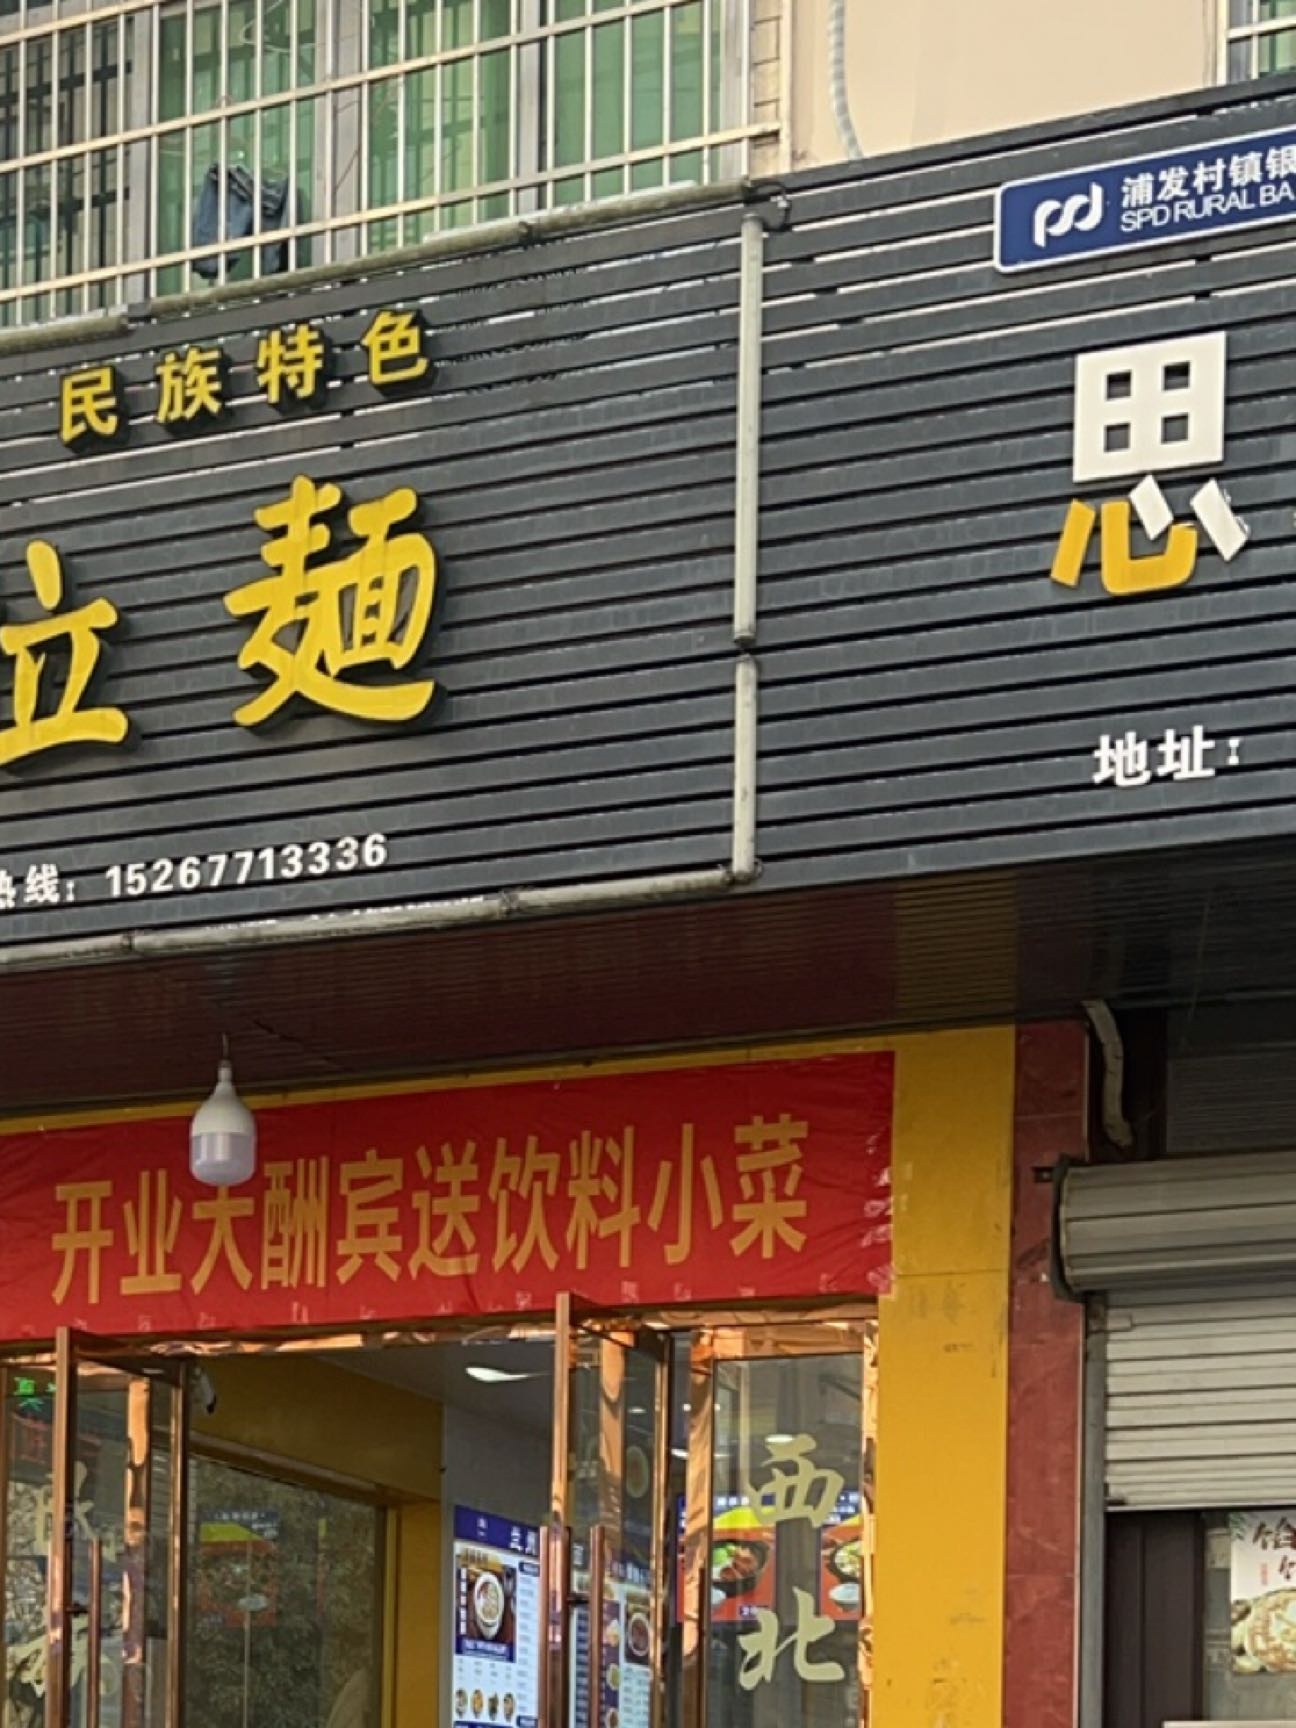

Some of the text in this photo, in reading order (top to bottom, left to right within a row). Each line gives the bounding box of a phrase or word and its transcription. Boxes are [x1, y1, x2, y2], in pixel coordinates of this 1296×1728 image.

[1120, 208, 1169, 232] SPD
[1173, 189, 1255, 222] RURAL
[60, 310, 431, 445] 民族特色
[1050, 331, 1249, 594] 思
[49, 1115, 809, 1305] 开业大酬宾送饮料小菜
